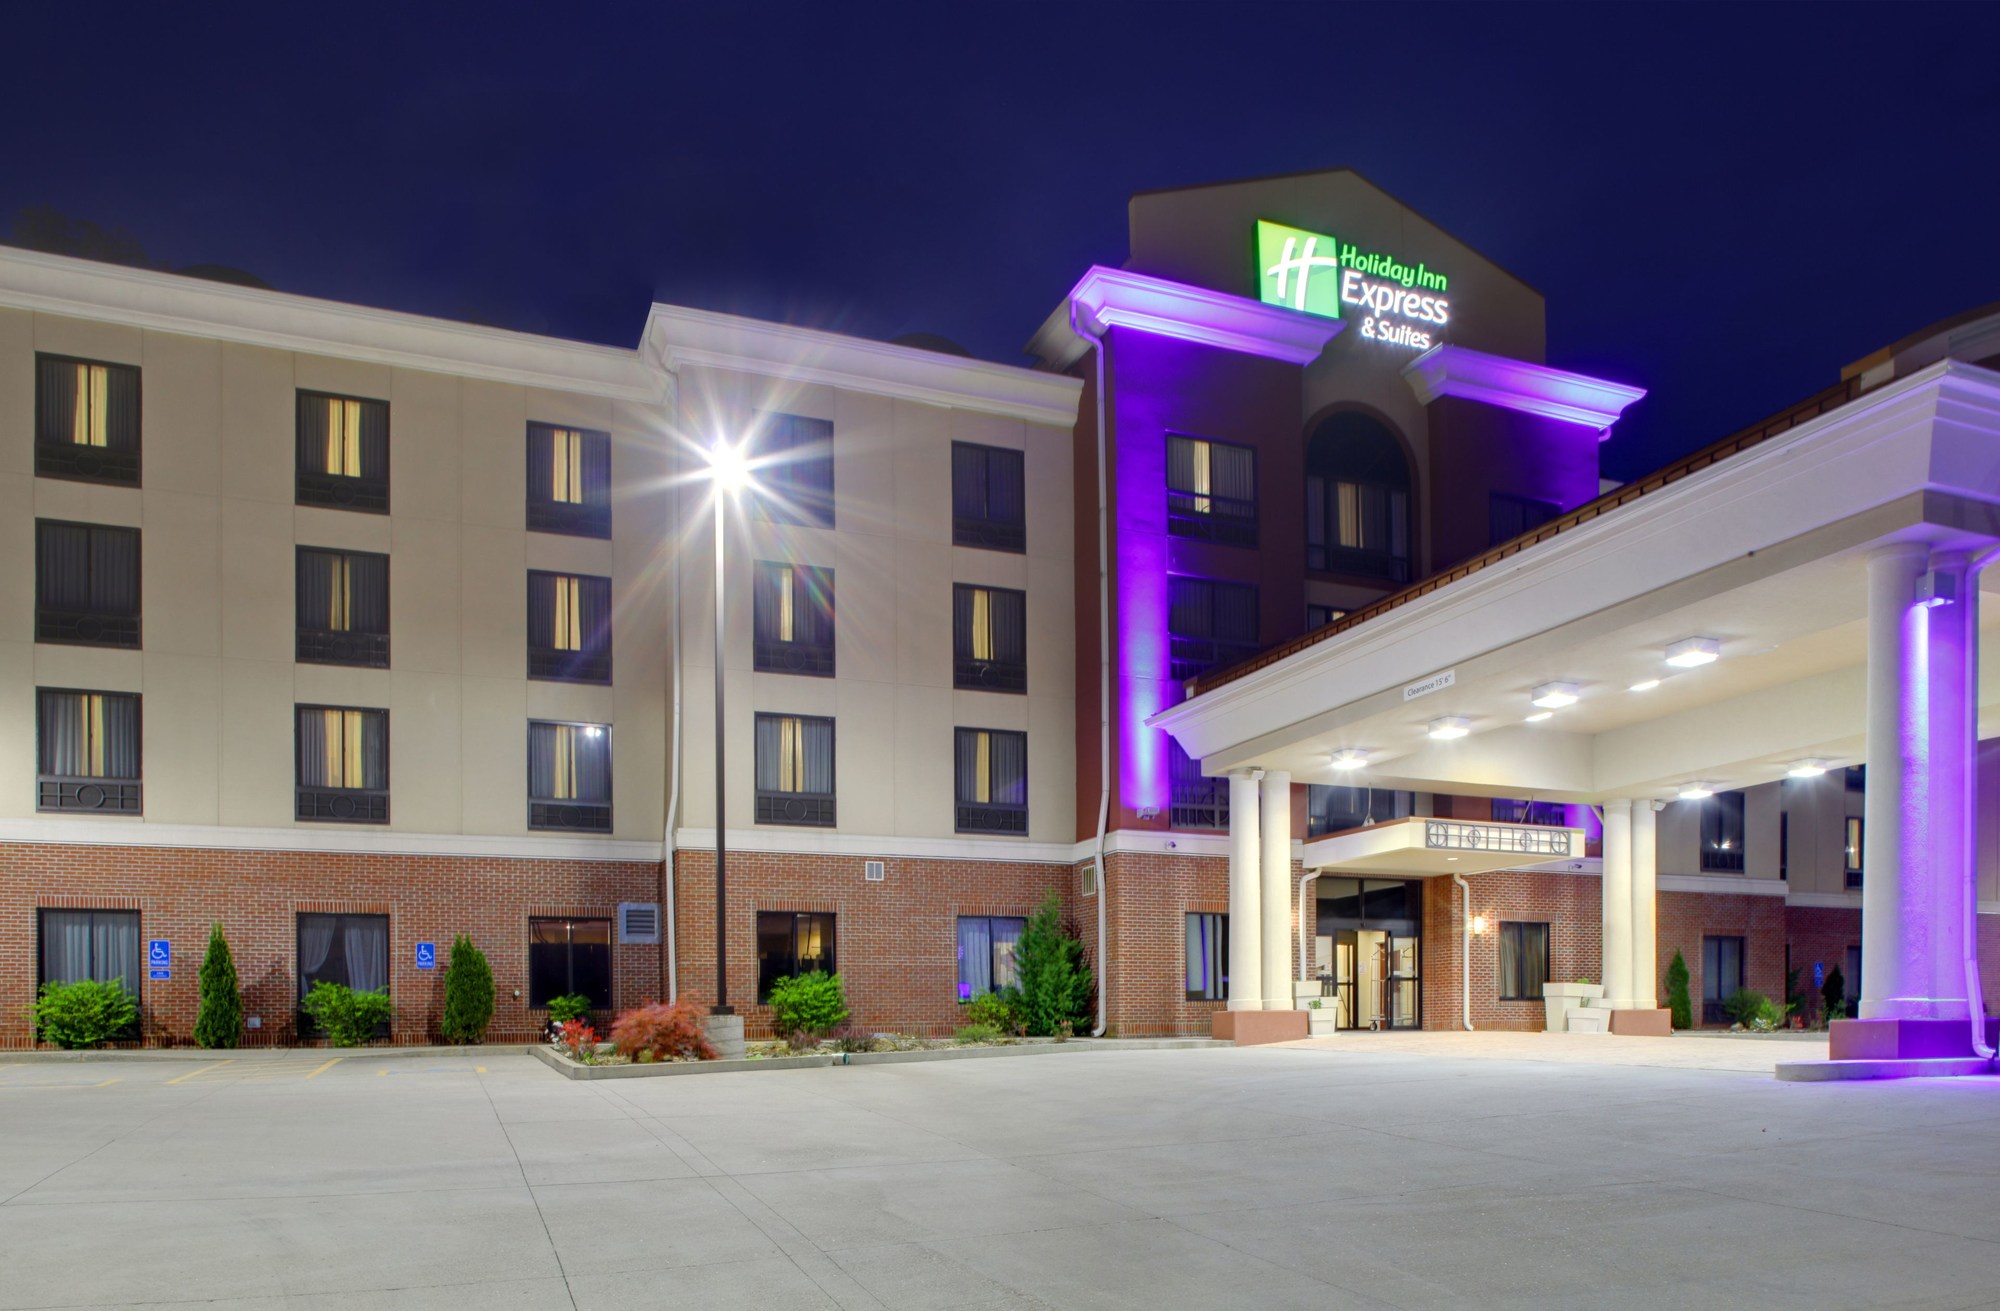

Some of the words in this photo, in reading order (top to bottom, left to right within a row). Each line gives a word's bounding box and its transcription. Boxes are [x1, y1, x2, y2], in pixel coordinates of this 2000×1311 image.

[1340, 244, 1414, 288] Holiday
[1416, 263, 1447, 291] Inn
[1341, 270, 1449, 324] Express
[1361, 317, 1375, 338] &
[1378, 320, 1431, 350] Suites
[1407, 682, 1435, 697] Clearance
